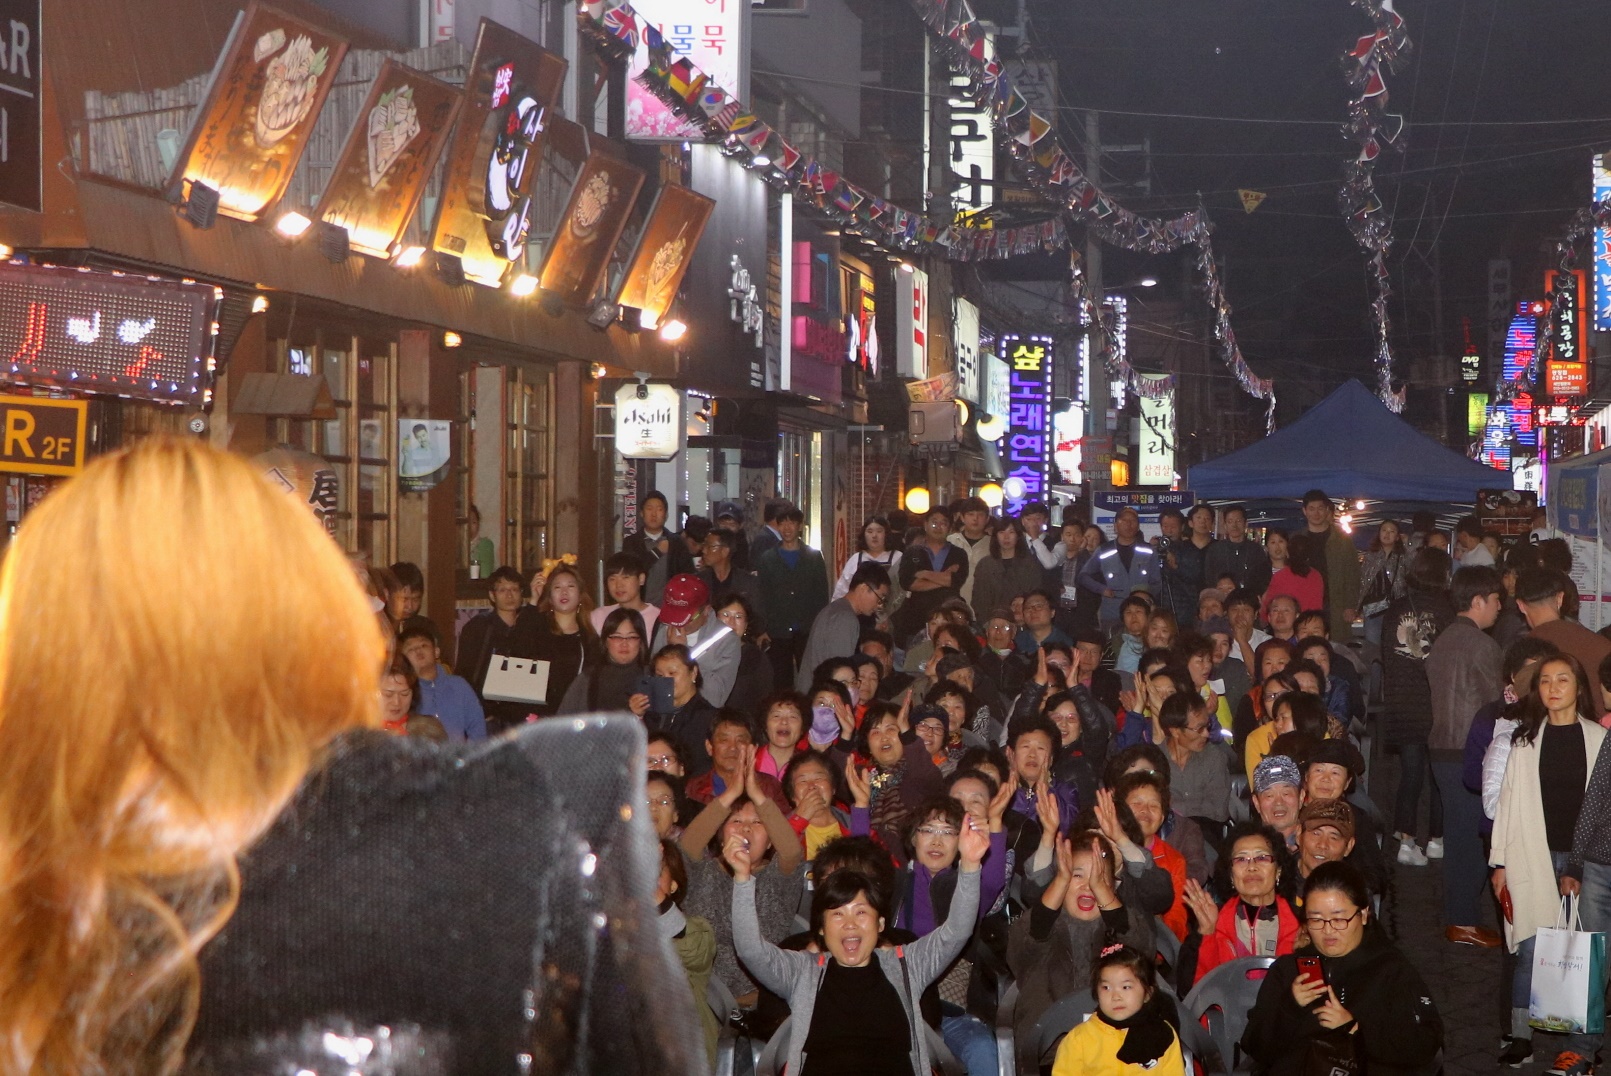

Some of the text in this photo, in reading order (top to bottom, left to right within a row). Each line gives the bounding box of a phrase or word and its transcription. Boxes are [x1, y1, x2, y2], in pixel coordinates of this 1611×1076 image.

[1513, 328, 1534, 432] 노래습장
[623, 407, 671, 424] Asahi
[641, 428, 653, 438] 生
[41, 436, 72, 461] 2F
[1144, 465, 1171, 477] 삼겹살
[1106, 494, 1183, 504] 최고의 맛집을 찾아라!
